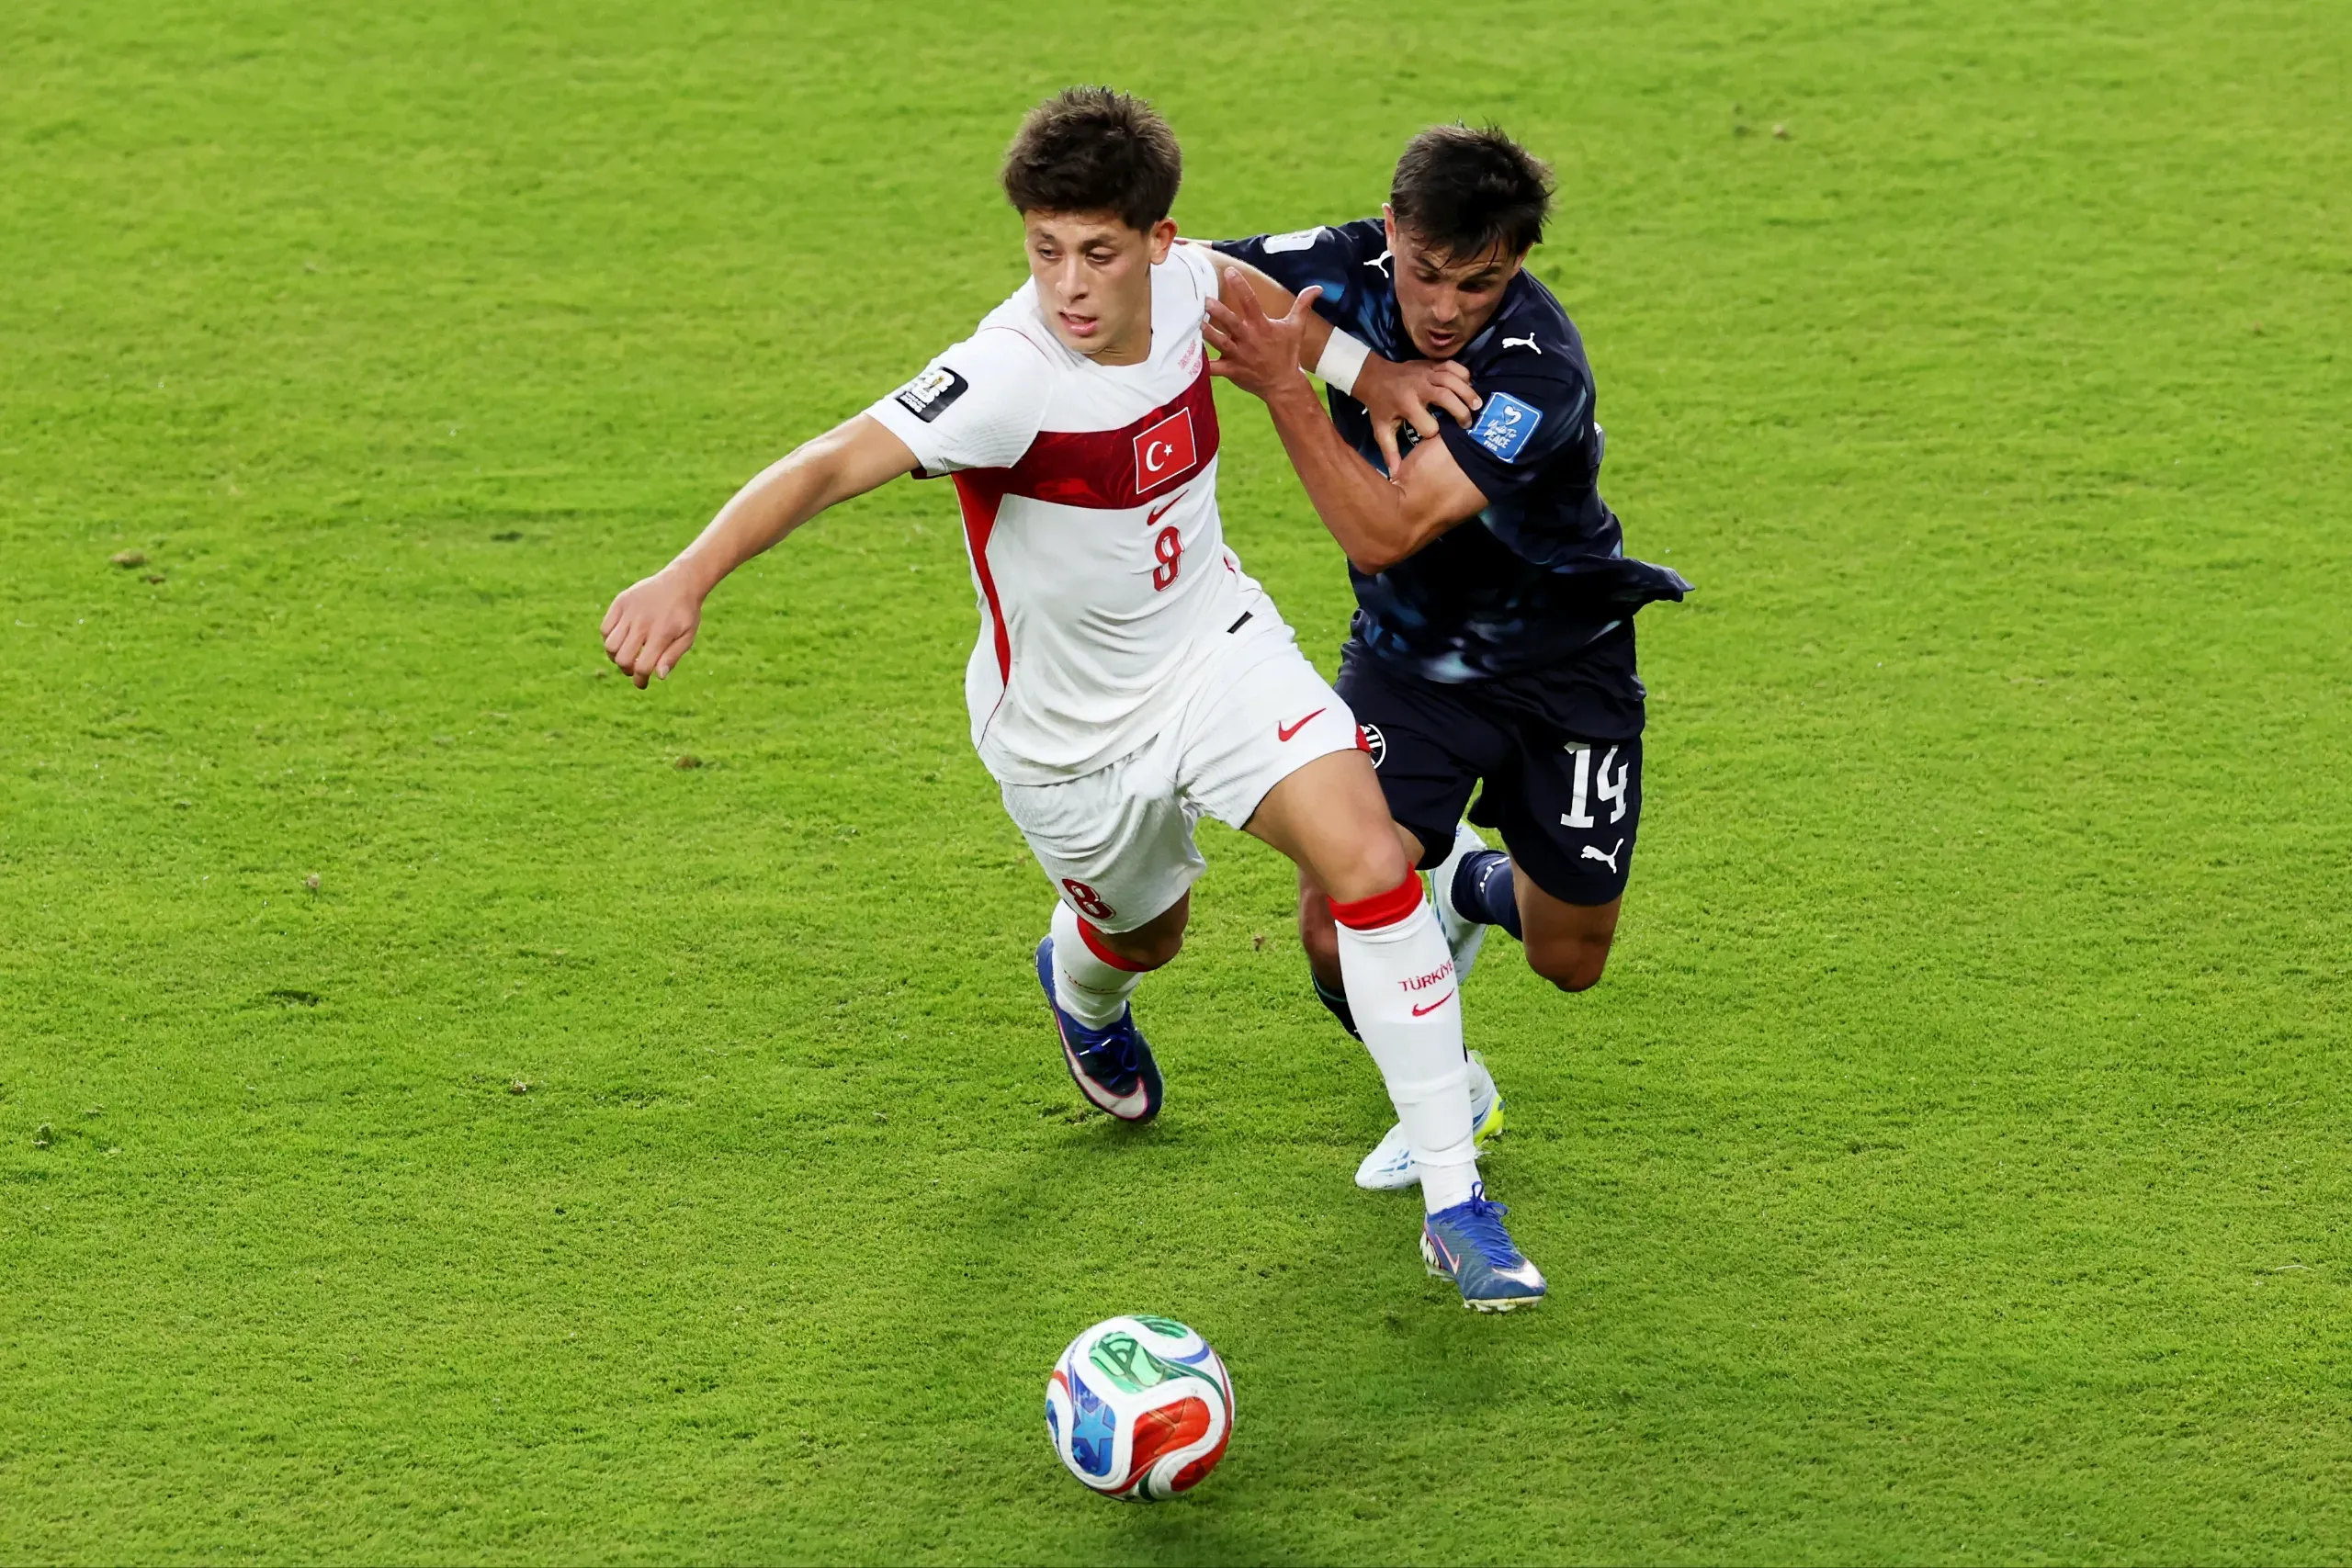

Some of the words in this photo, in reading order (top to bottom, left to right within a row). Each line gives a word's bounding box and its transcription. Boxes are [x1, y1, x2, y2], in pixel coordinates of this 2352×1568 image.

[1483, 428, 1511, 449] PEACE
[1483, 440, 1498, 452] FIFA
[1560, 740, 1630, 829] 14
[1061, 878, 1117, 920] 8
